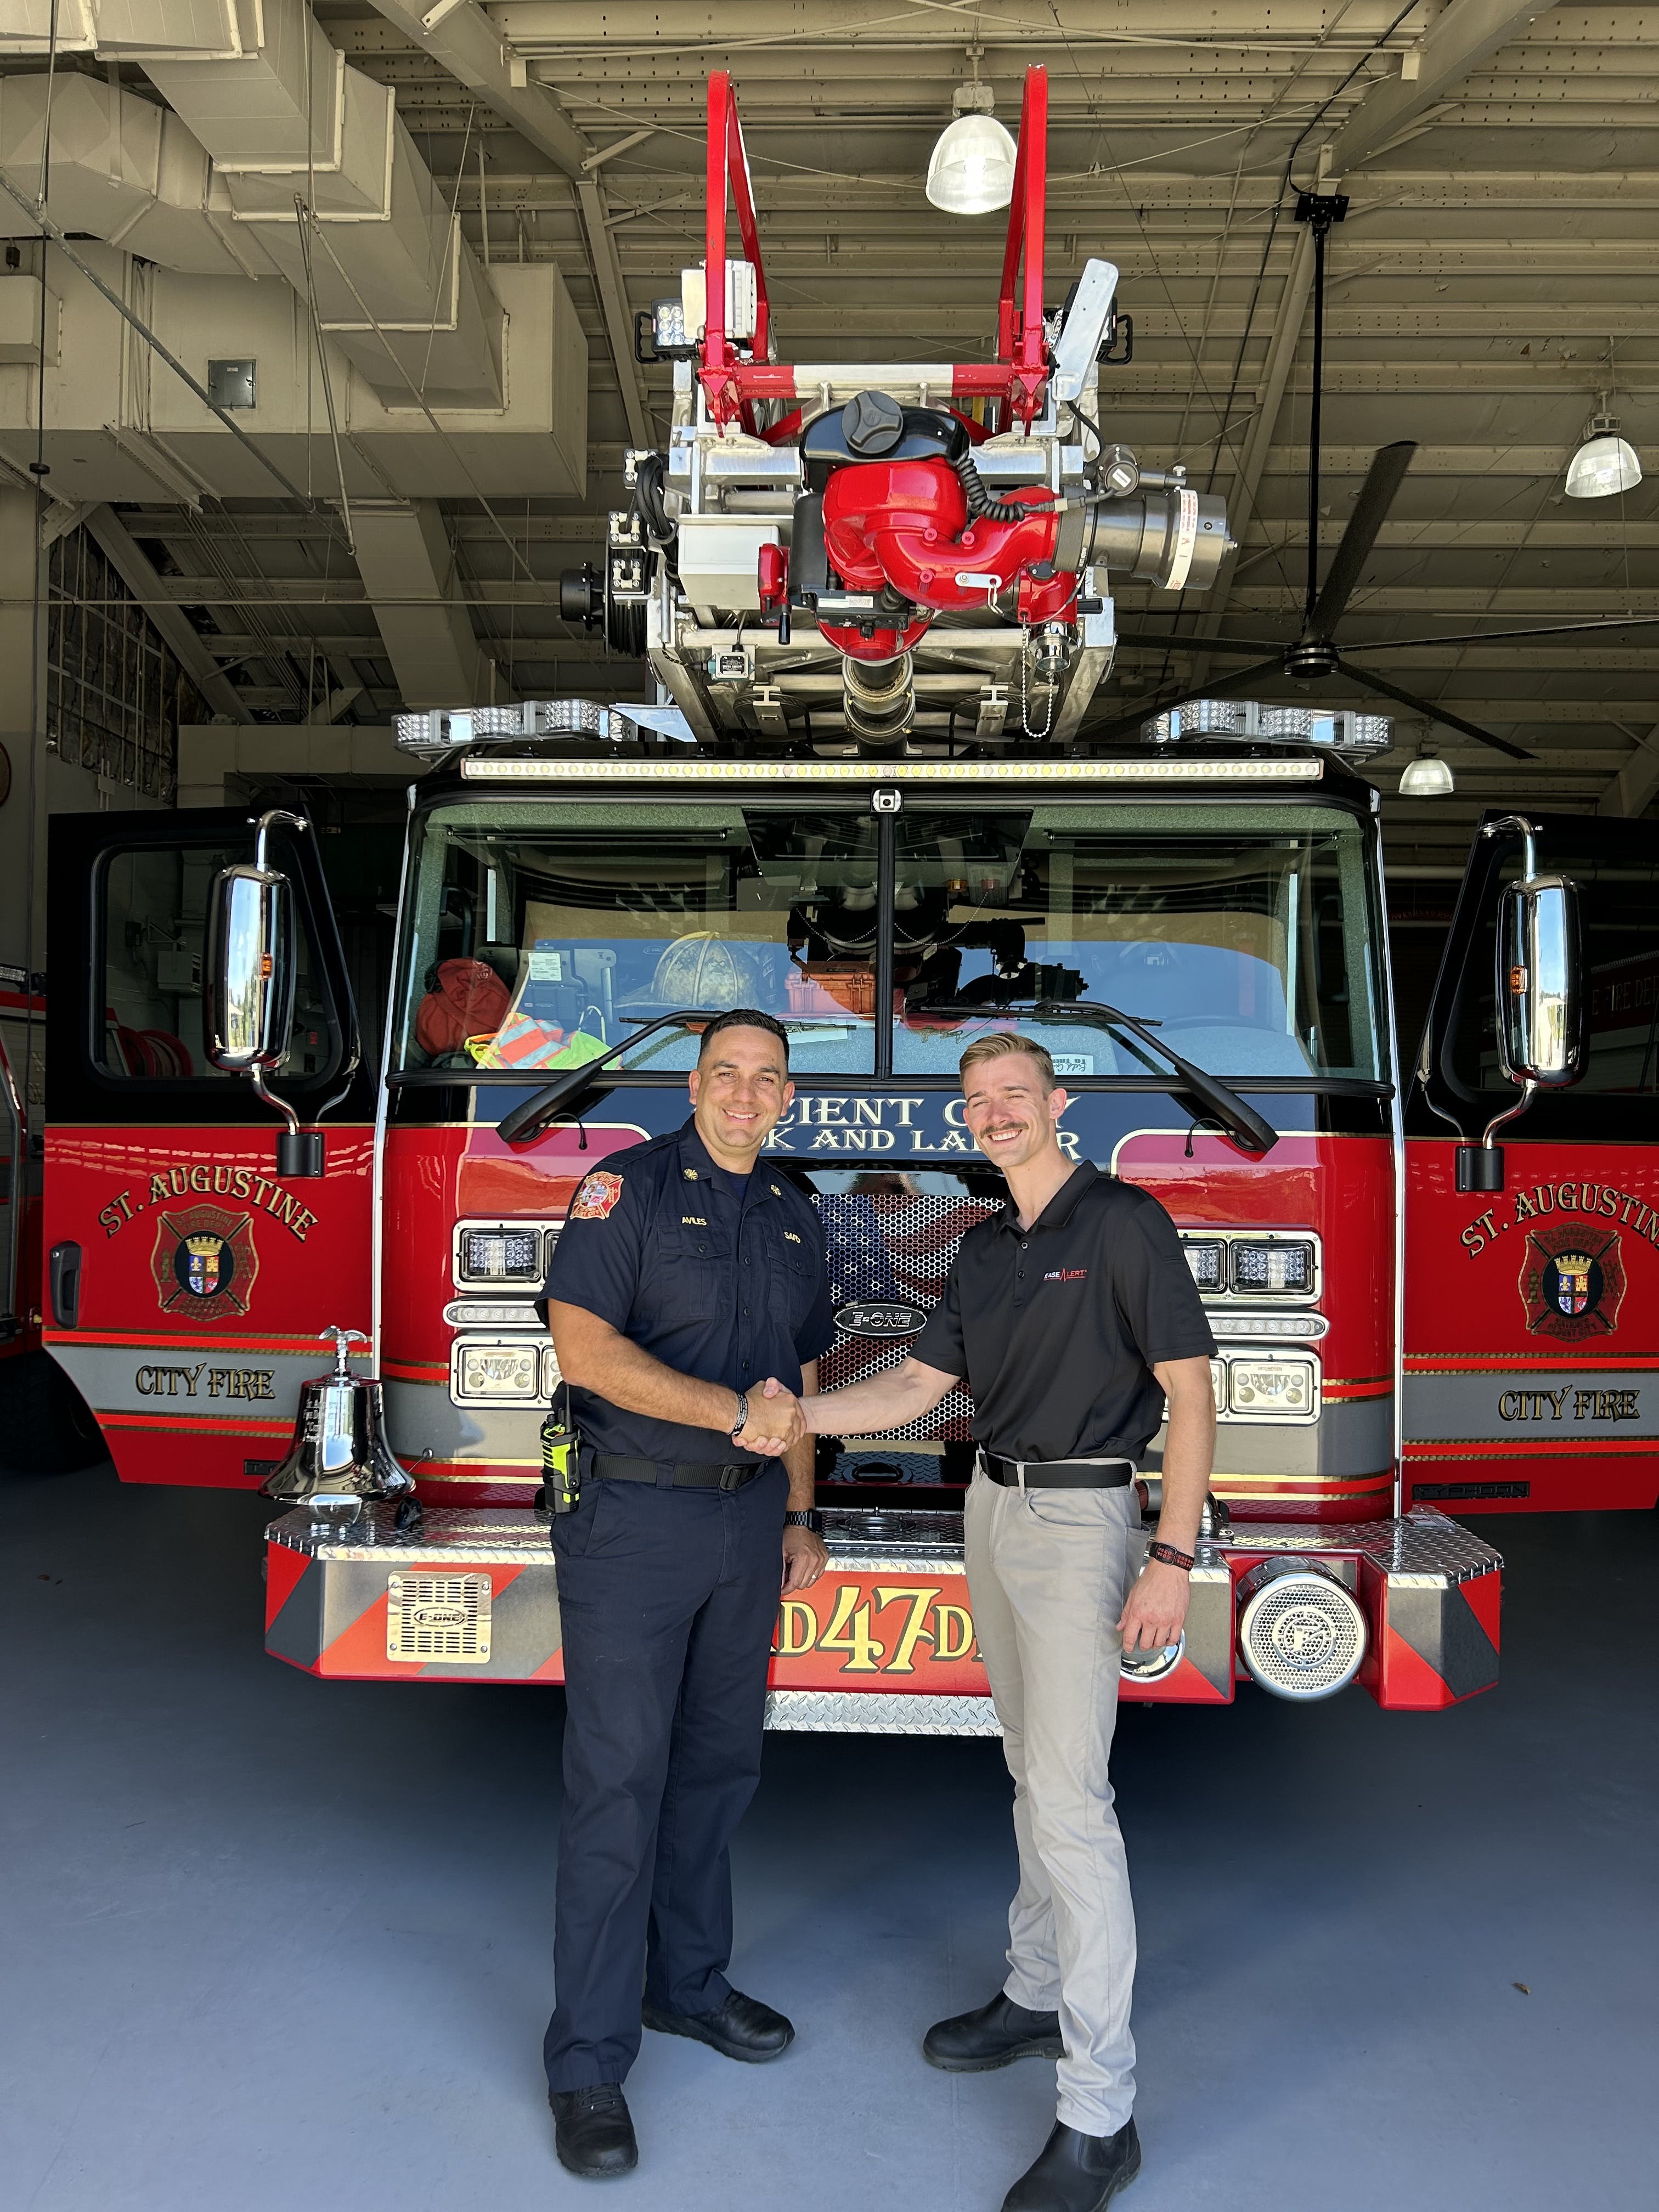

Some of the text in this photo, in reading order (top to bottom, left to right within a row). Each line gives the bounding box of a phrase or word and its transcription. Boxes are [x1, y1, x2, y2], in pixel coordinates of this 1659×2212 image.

[1634, 975, 1659, 1008] DEP
[776, 1097, 925, 1126] CIENT
[812, 1128, 896, 1152] AND
[99, 1165, 319, 1241] ST. AUGUSTINE
[682, 1216, 707, 1226] AVILES
[1460, 1182, 1659, 1260] ST. AUGUSTIN
[849, 1312, 912, 1327] E-ONE
[136, 1363, 276, 1401] CITY FIRE
[1498, 1385, 1640, 1423] CITY FIRE
